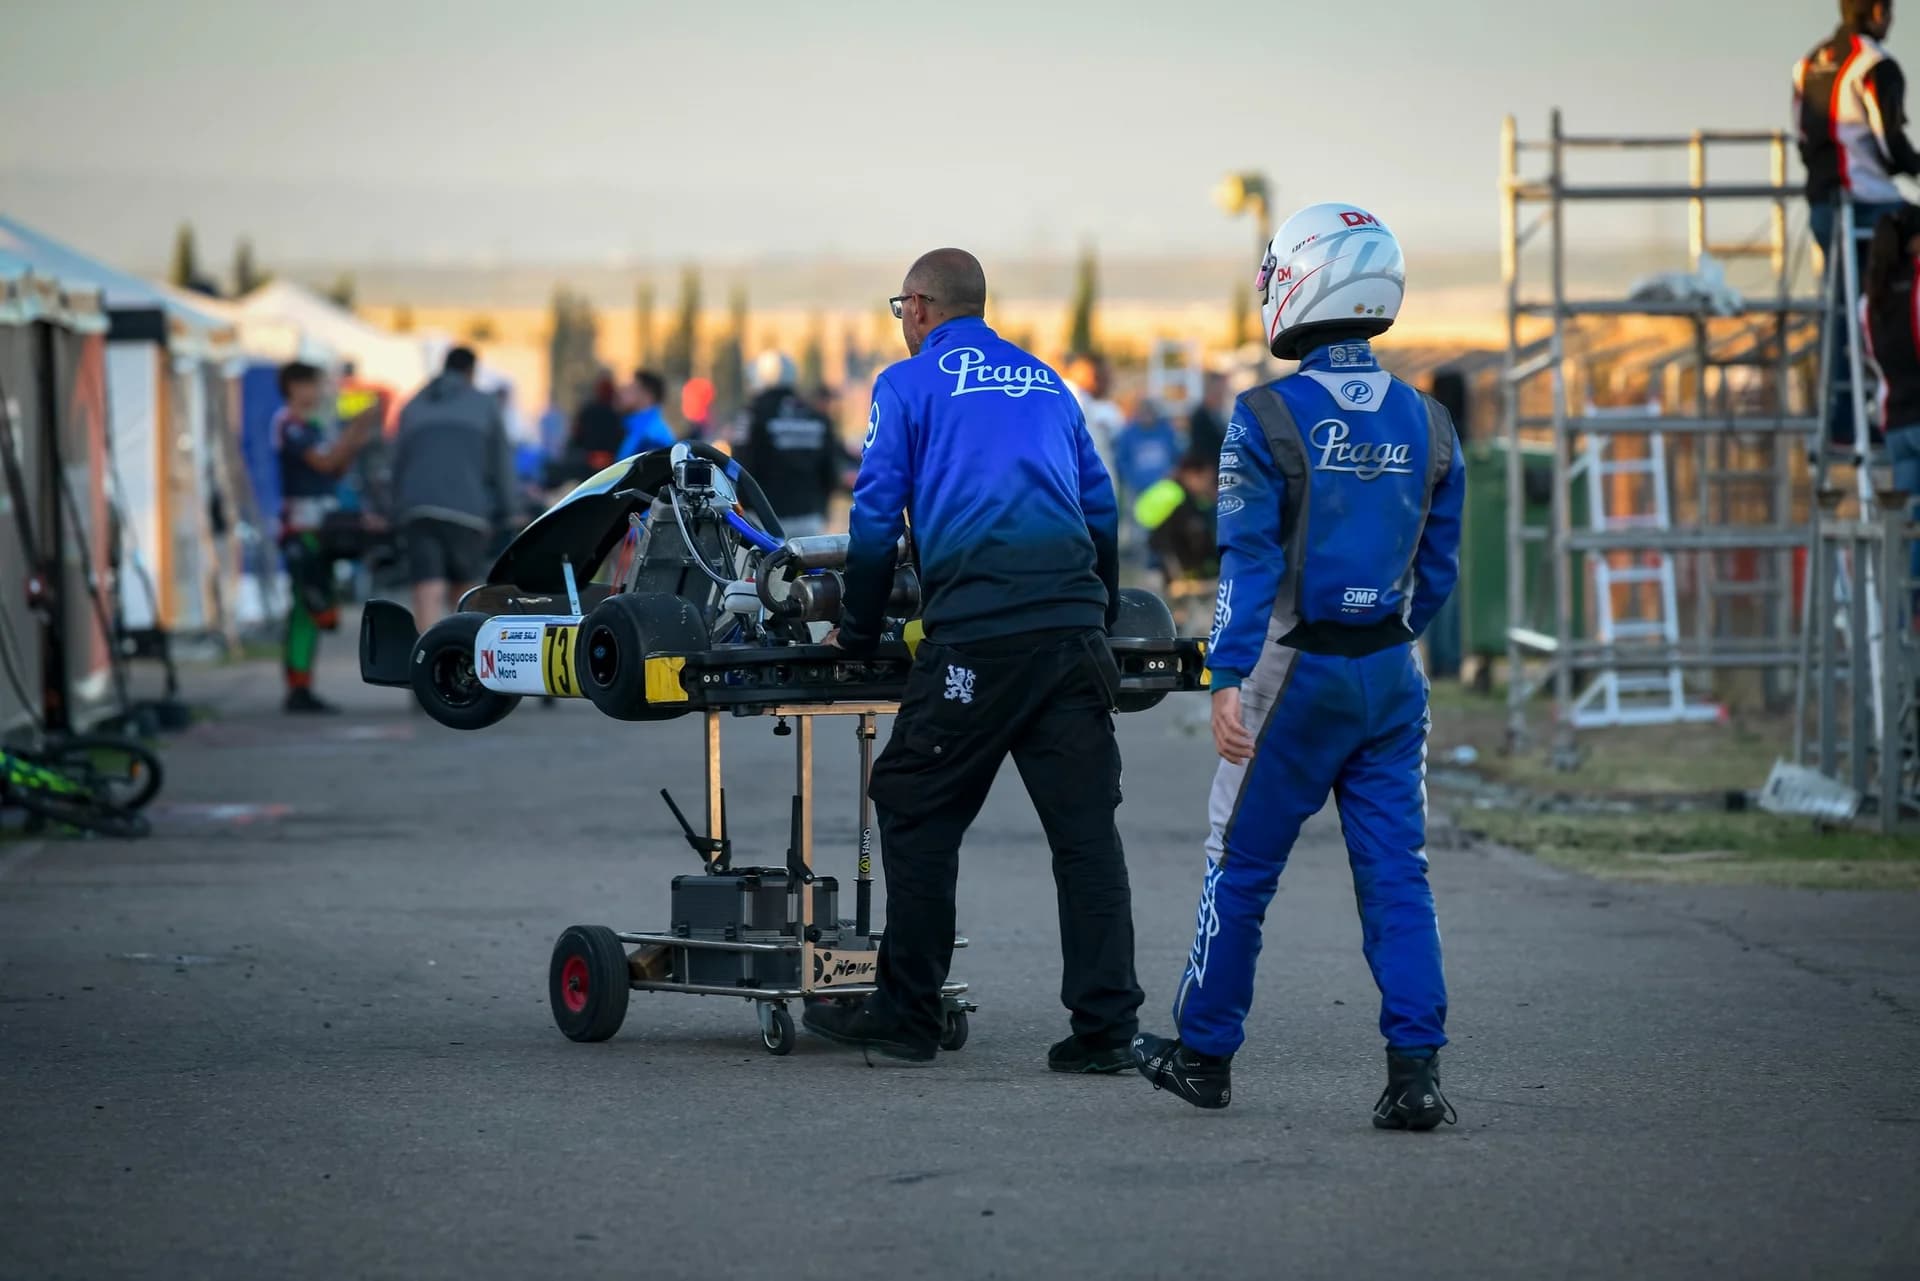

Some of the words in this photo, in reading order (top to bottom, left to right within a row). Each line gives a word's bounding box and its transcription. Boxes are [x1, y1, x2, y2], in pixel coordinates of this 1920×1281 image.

[938, 347, 1060, 398] Praga
[1309, 418, 1414, 481] Praga
[1343, 590, 1378, 604] OMP
[497, 650, 538, 666] Desguaces
[498, 666, 517, 679] Mora
[545, 627, 572, 695] 73
